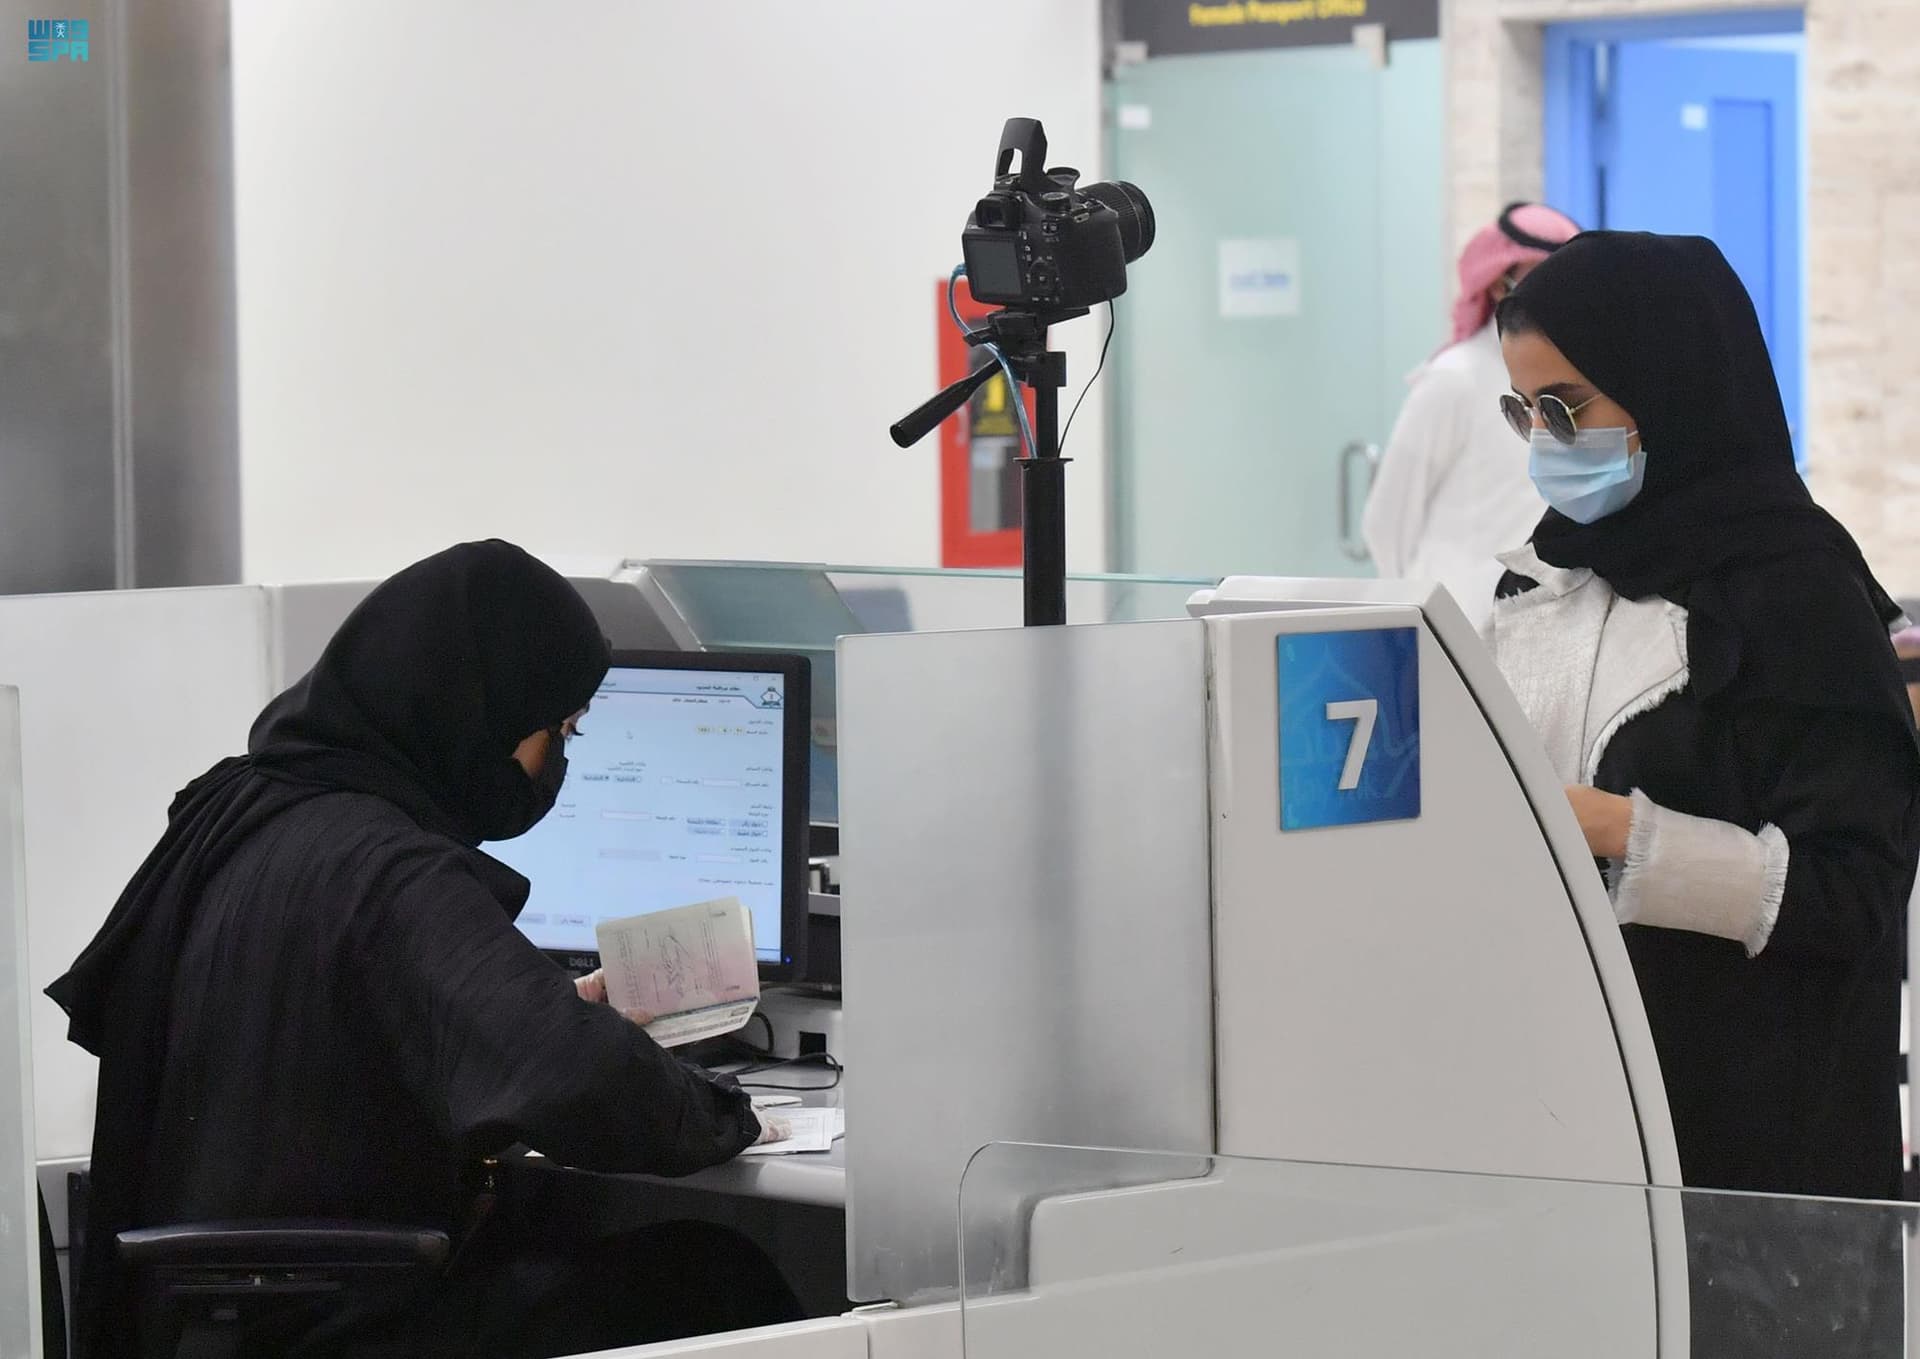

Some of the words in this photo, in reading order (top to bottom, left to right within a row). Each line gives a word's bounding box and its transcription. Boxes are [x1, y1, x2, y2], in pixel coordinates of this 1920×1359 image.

[1188, 3, 1244, 26] Female
[1246, 1, 1315, 25] Passport
[1317, 0, 1367, 18] Office
[1326, 699, 1378, 790] 7
